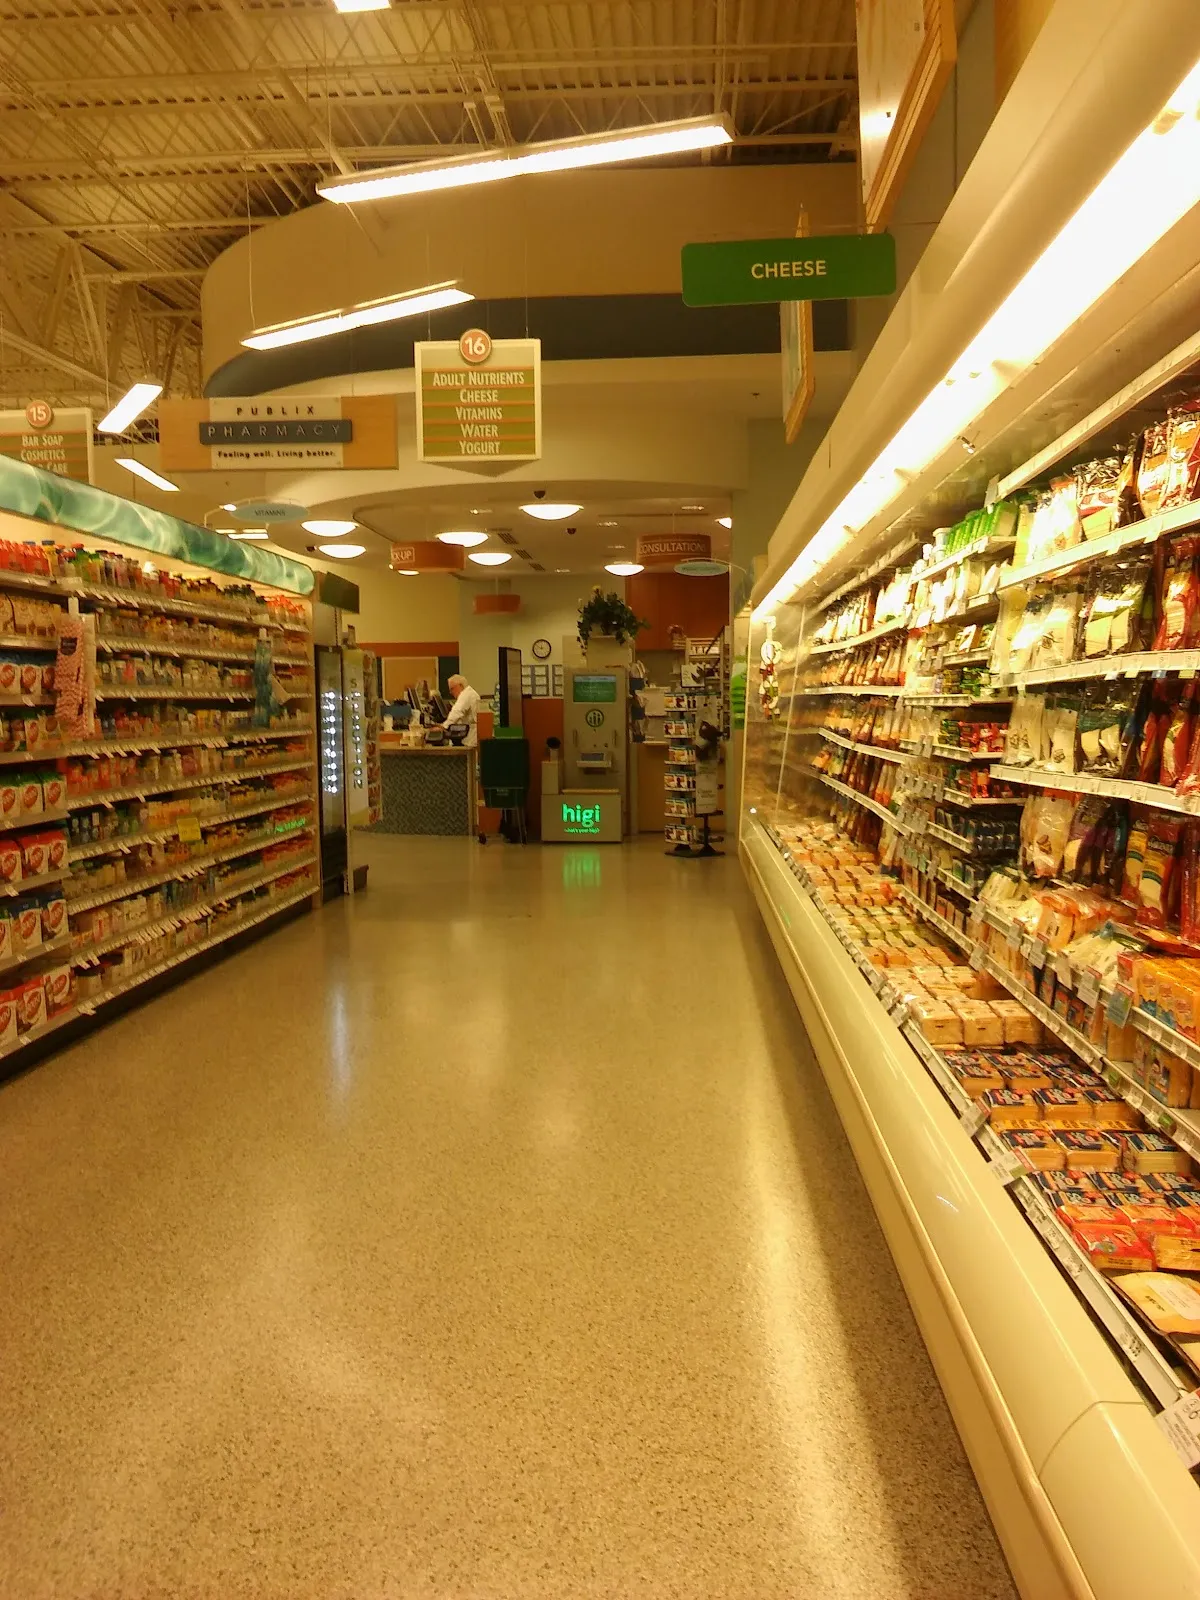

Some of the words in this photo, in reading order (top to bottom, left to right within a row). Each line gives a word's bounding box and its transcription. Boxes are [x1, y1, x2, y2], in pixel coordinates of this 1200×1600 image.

[751, 260, 827, 279] CHEESE
[465, 337, 486, 355] 16
[433, 372, 466, 386] ADULT
[468, 371, 525, 386] NUTRIENTS
[460, 389, 499, 403] CHEESE
[30, 405, 47, 421] 15
[236, 405, 315, 416] PUBLIX
[456, 407, 503, 421] VITAMINS
[208, 424, 341, 438] PHARMACY
[460, 424, 499, 438] WATER
[22, 435, 39, 447] BAR
[42, 434, 64, 446] SOAP
[21, 449, 66, 461] COSMETICS
[217, 450, 250, 459] Feeling
[253, 450, 274, 458] well.
[277, 450, 303, 459] Living
[306, 449, 336, 458] better.
[459, 441, 500, 455] YOGURT
[47, 462, 69, 473] CARE
[563, 804, 600, 828] higi
